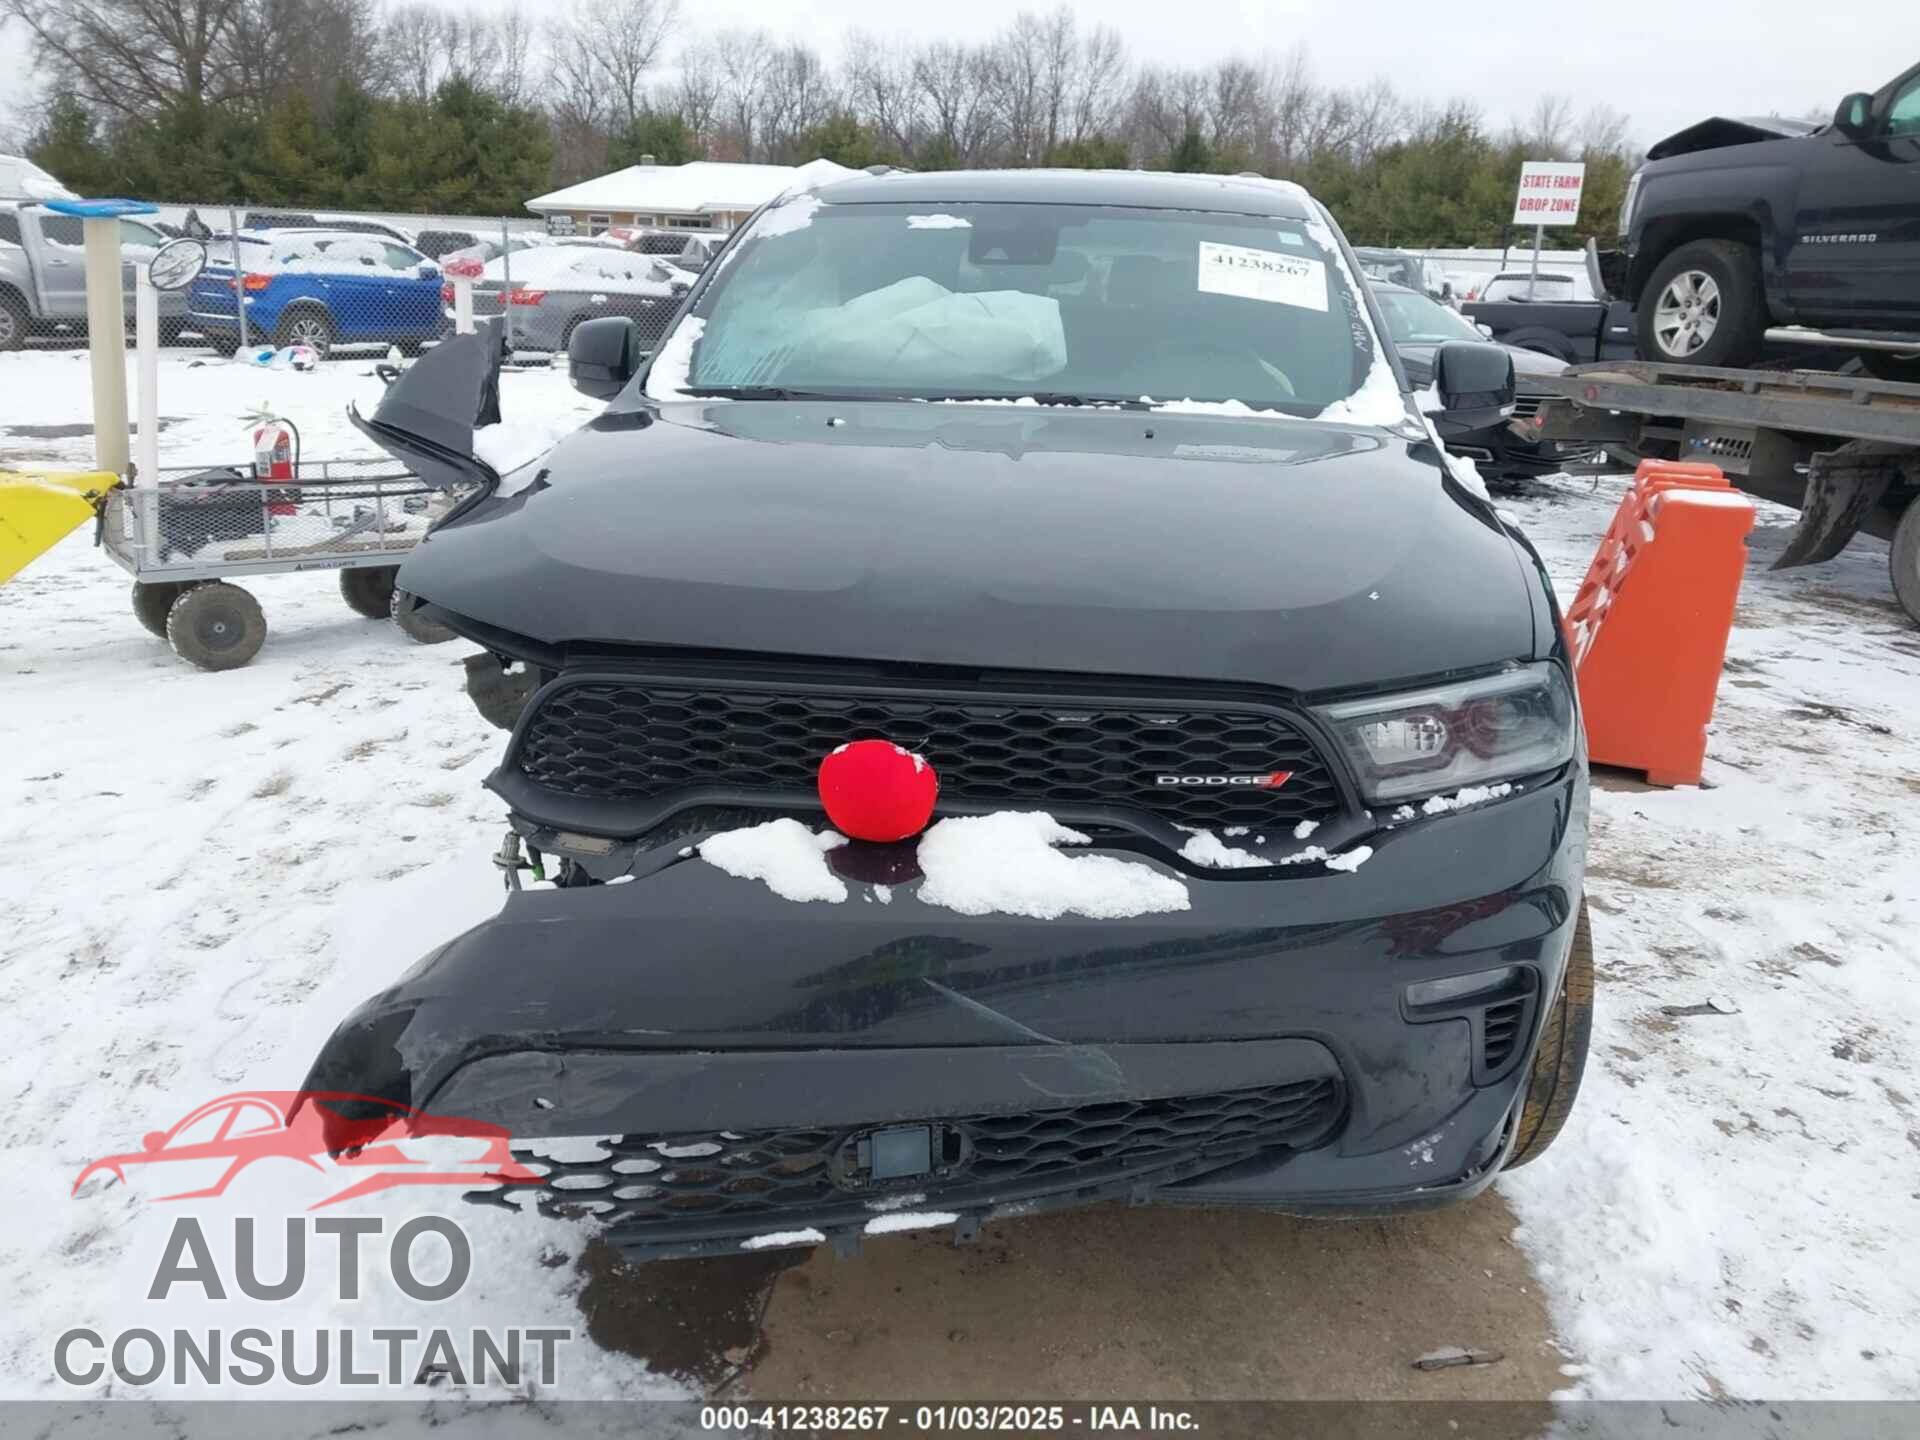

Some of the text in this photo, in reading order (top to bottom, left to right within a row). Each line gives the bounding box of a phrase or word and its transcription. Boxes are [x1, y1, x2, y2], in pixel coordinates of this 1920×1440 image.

[1522, 175, 1581, 189] STATE FARM
[1519, 198, 1577, 212] DROP ZONE
[1801, 233, 1877, 244] SILVERADO
[1212, 254, 1310, 277] 41238267
[1156, 775, 1274, 785] DODGE
